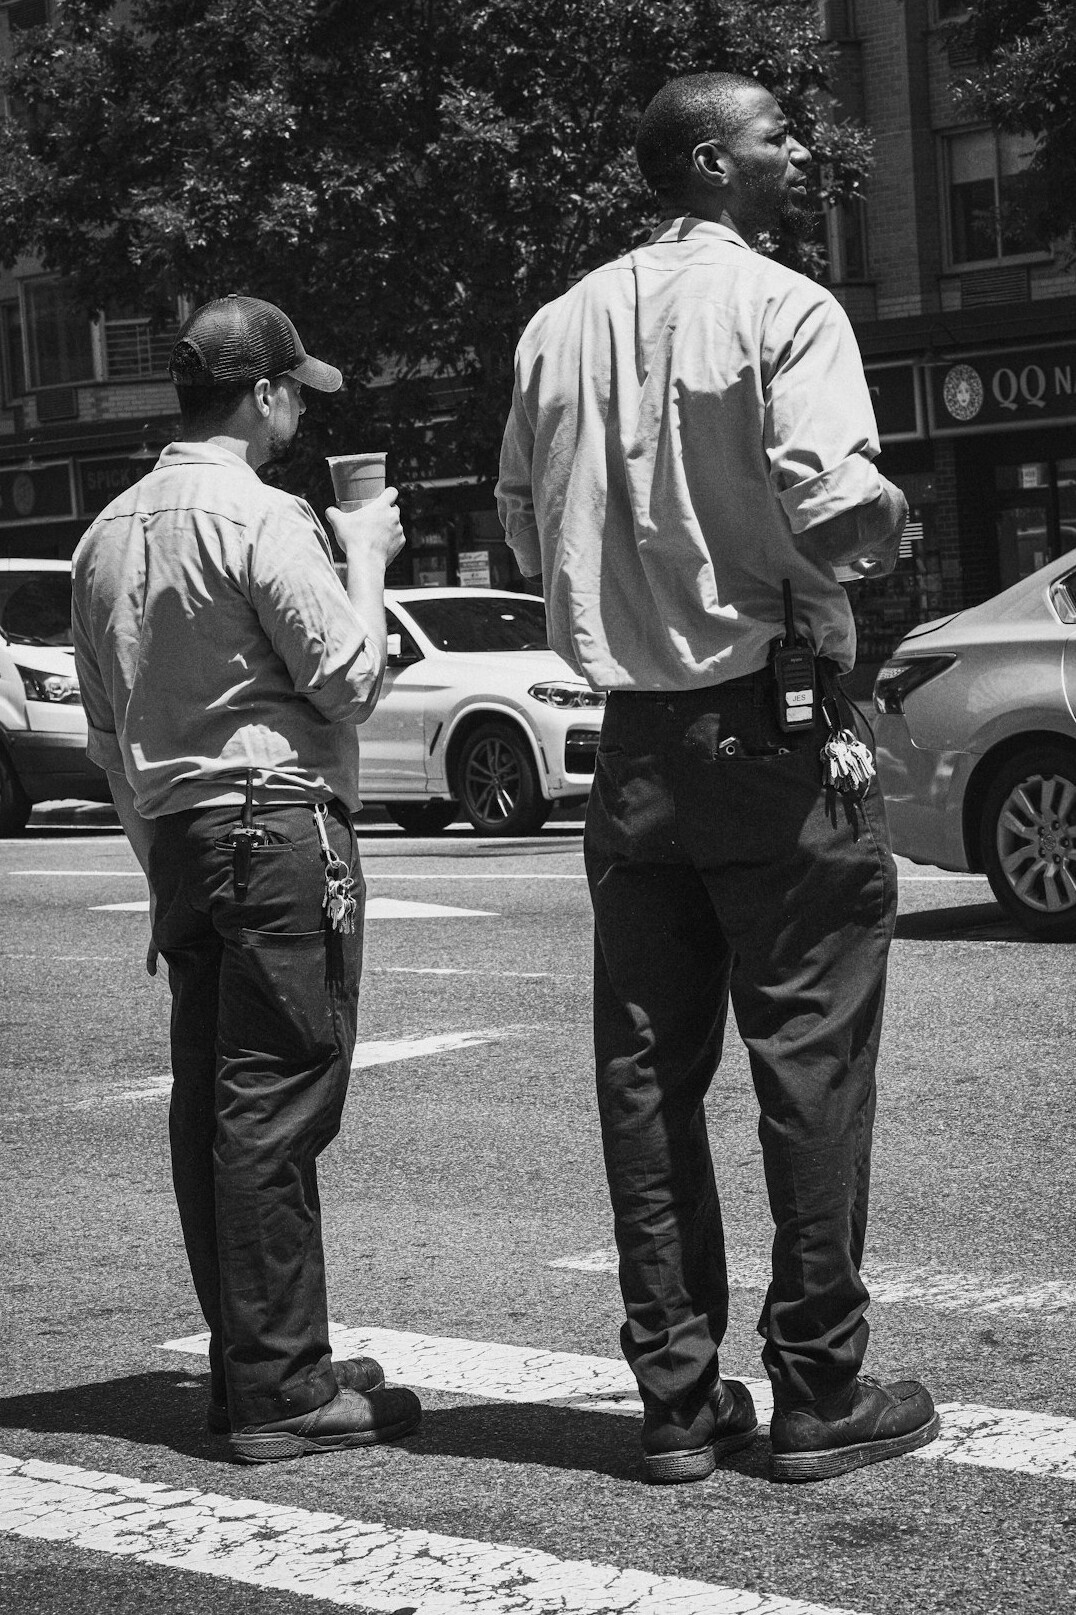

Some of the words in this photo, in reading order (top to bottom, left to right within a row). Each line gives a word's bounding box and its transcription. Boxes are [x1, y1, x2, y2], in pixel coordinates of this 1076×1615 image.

[992, 365, 1046, 410] QQ
[1054, 364, 1076, 396] N
[792, 694, 806, 702] JES
